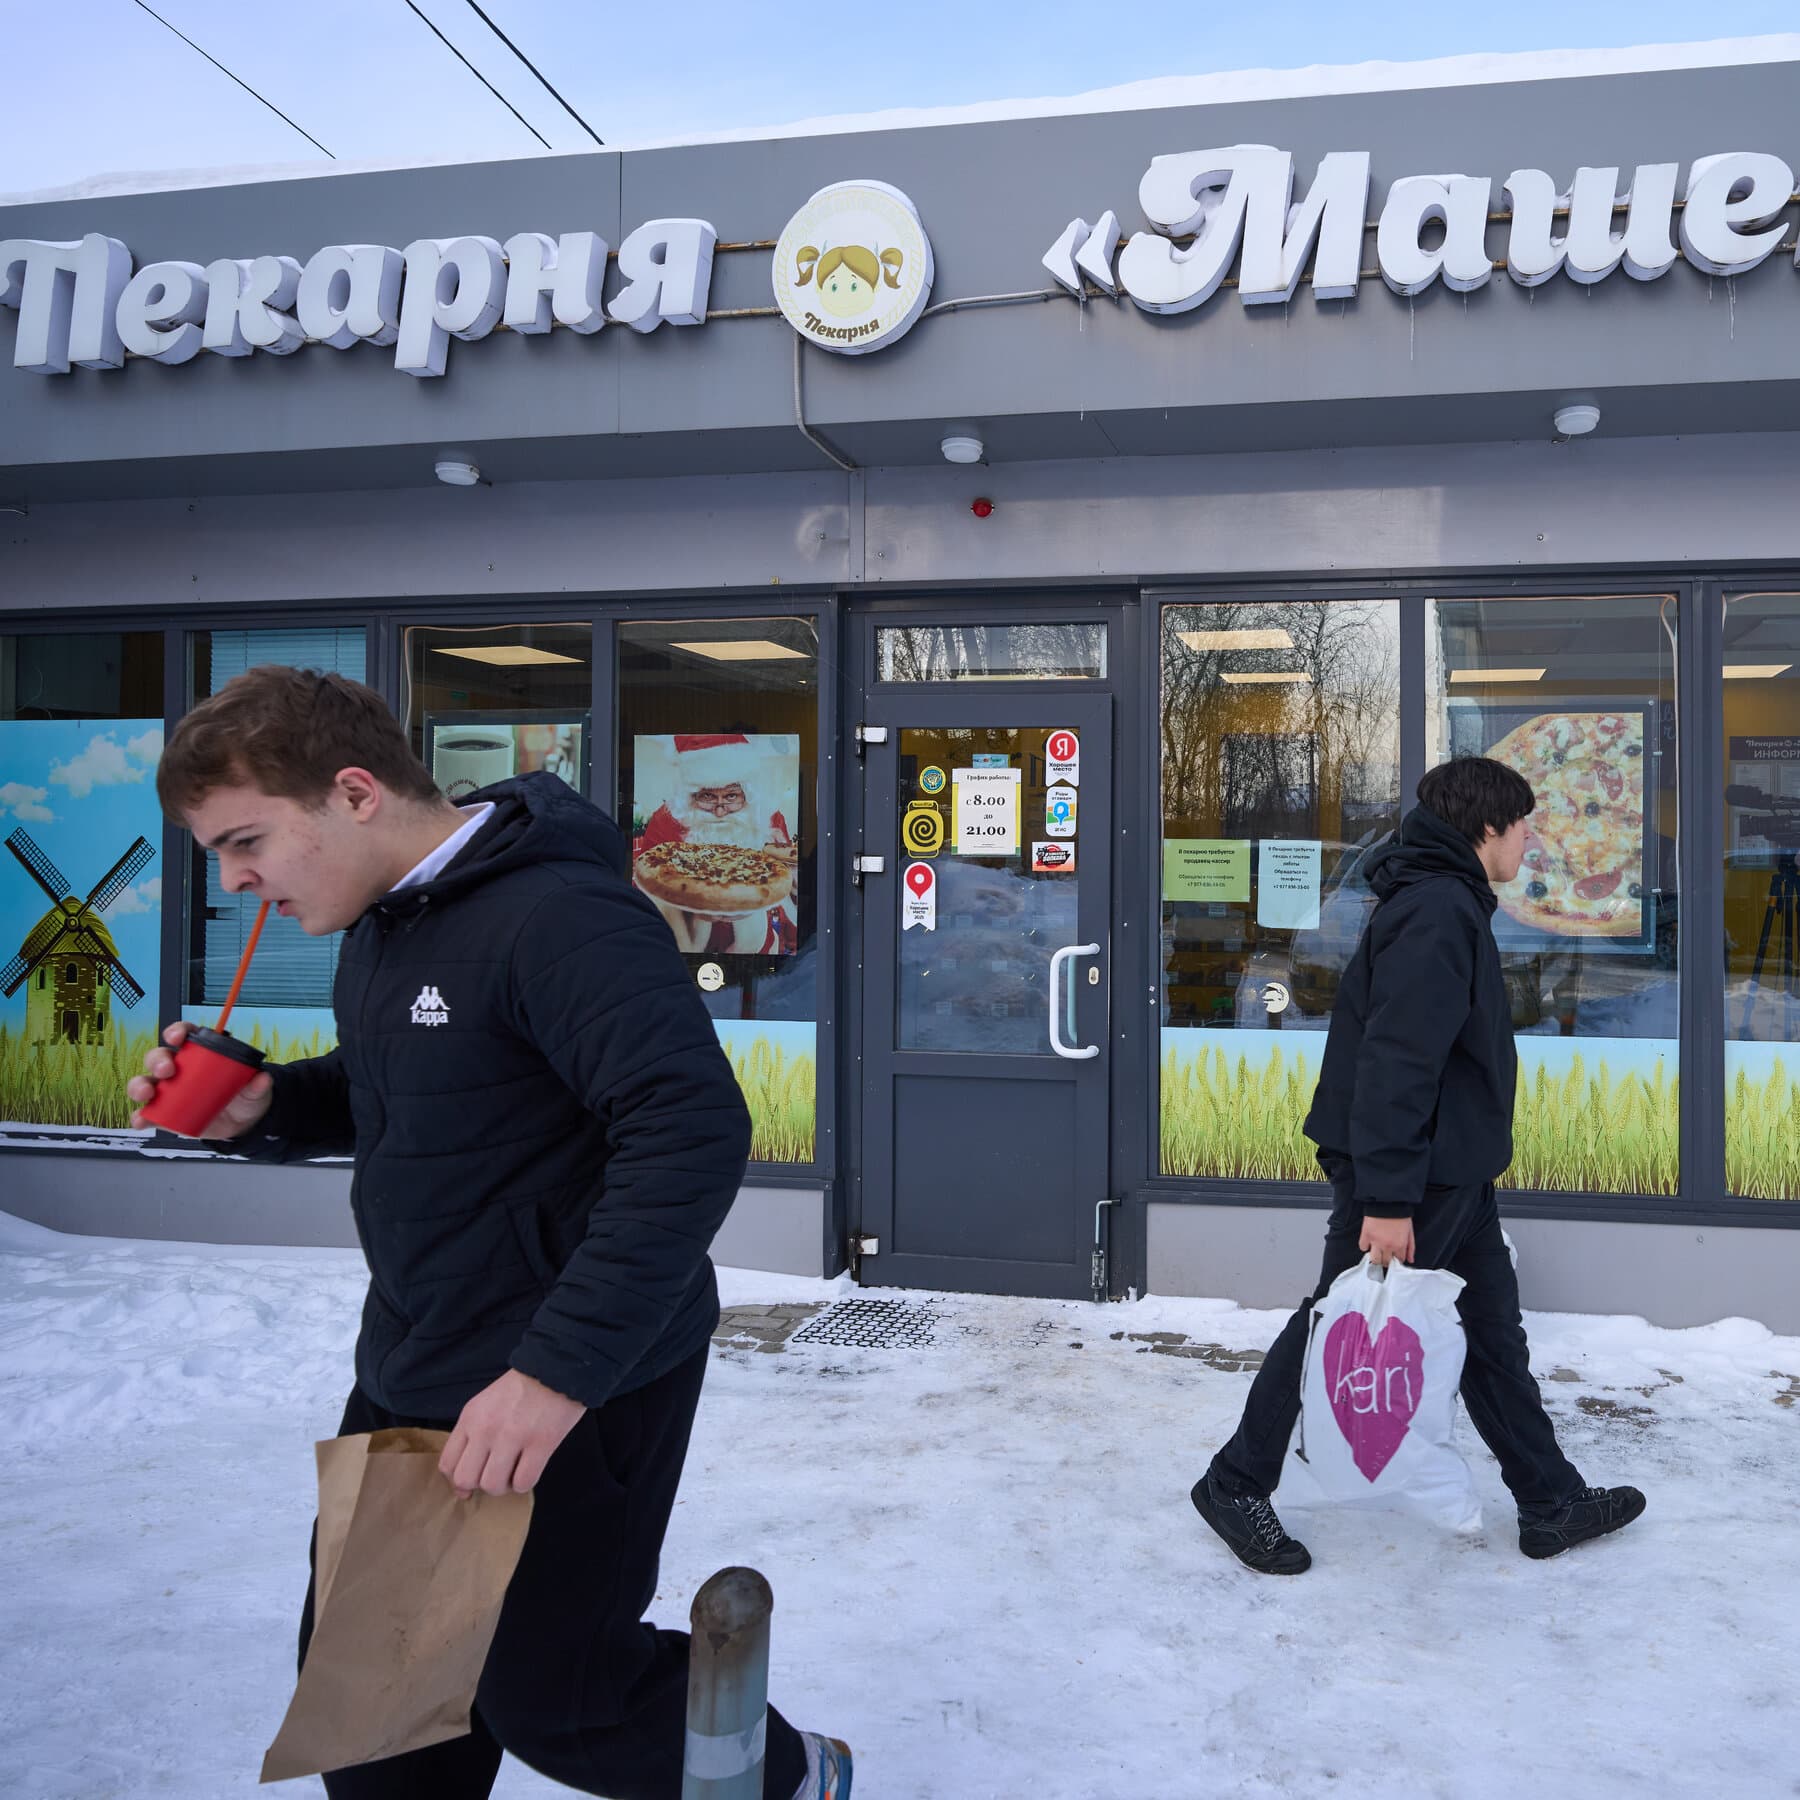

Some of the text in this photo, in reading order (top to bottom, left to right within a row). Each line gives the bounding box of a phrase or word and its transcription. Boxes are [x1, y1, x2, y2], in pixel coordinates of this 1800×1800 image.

[0, 144, 1800, 376] Пекарня «Маше
[804, 312, 880, 342] Пекарня
[1056, 737, 1069, 756] Я
[973, 794, 1006, 806] 8.00
[966, 826, 1006, 836] 21.00
[412, 1009, 449, 1027] Kappa
[1333, 1339, 1415, 1415] kari
